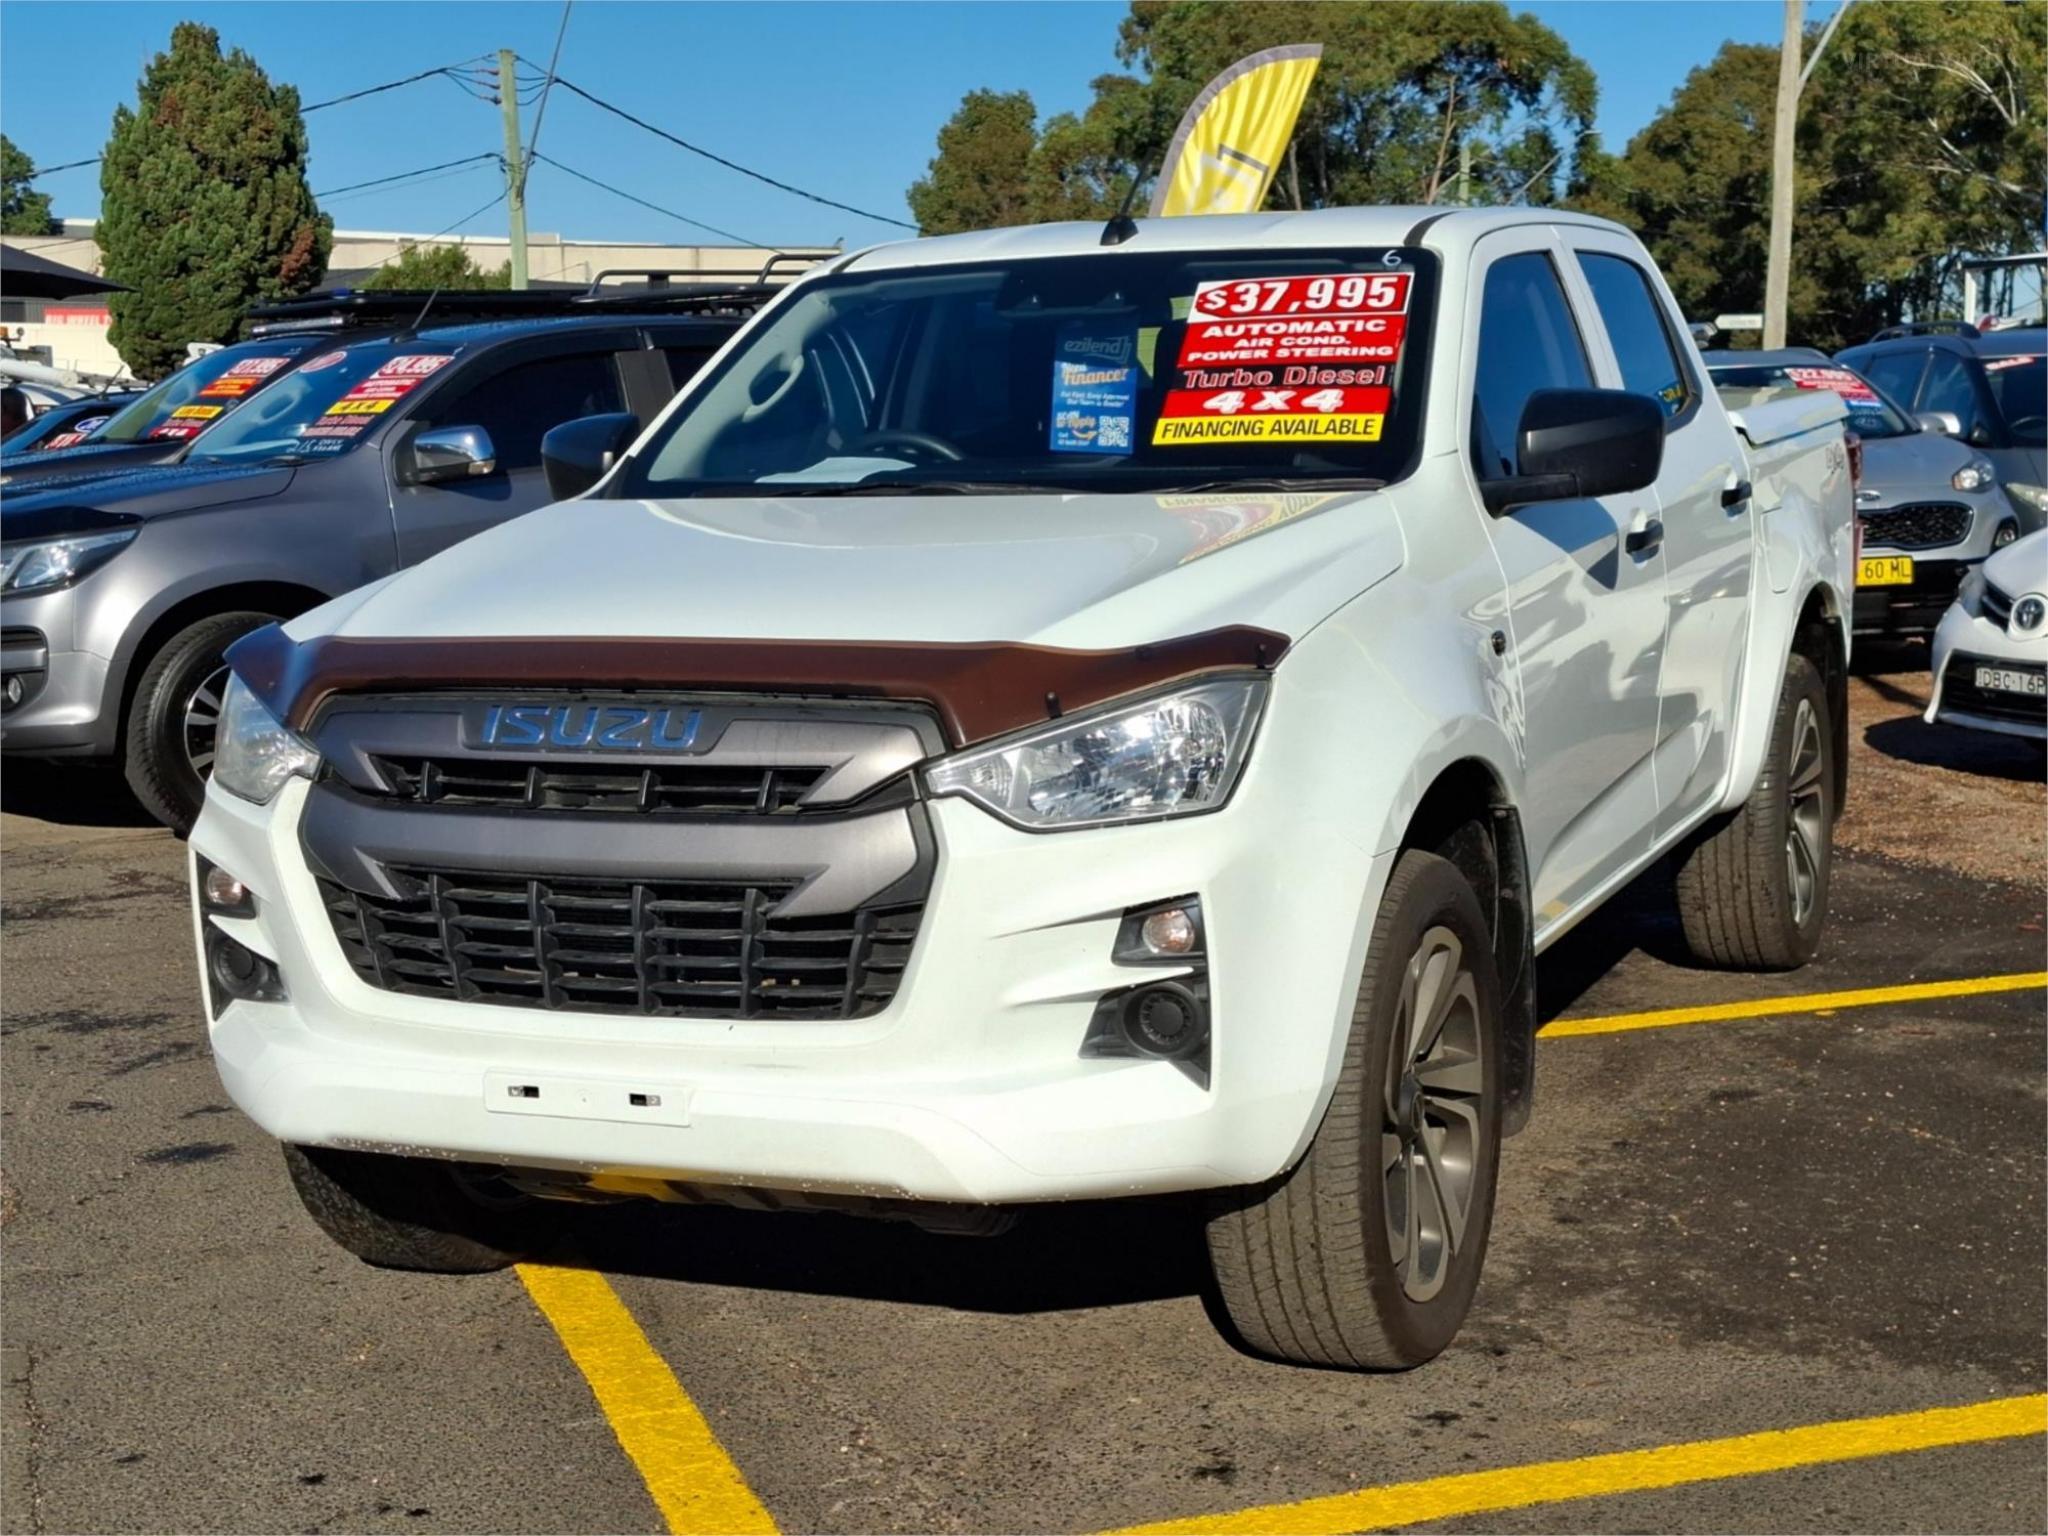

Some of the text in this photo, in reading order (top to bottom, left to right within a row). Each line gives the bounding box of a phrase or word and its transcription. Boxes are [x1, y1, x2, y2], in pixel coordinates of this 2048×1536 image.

[1382, 249, 1402, 267] 6
[1204, 276, 1399, 314] $37,995
[1201, 319, 1387, 339] AUTOMATIC
[1064, 337, 1122, 354] ezilend
[1233, 336, 1352, 349] AIR COND.
[1187, 346, 1394, 363] POWER STEERING
[1184, 364, 1386, 389] Turbo Diesel
[1162, 418, 1375, 439] FINANCING AVAILABLE
[1890, 558, 1911, 578] ML
[482, 705, 704, 748] ISUZU
